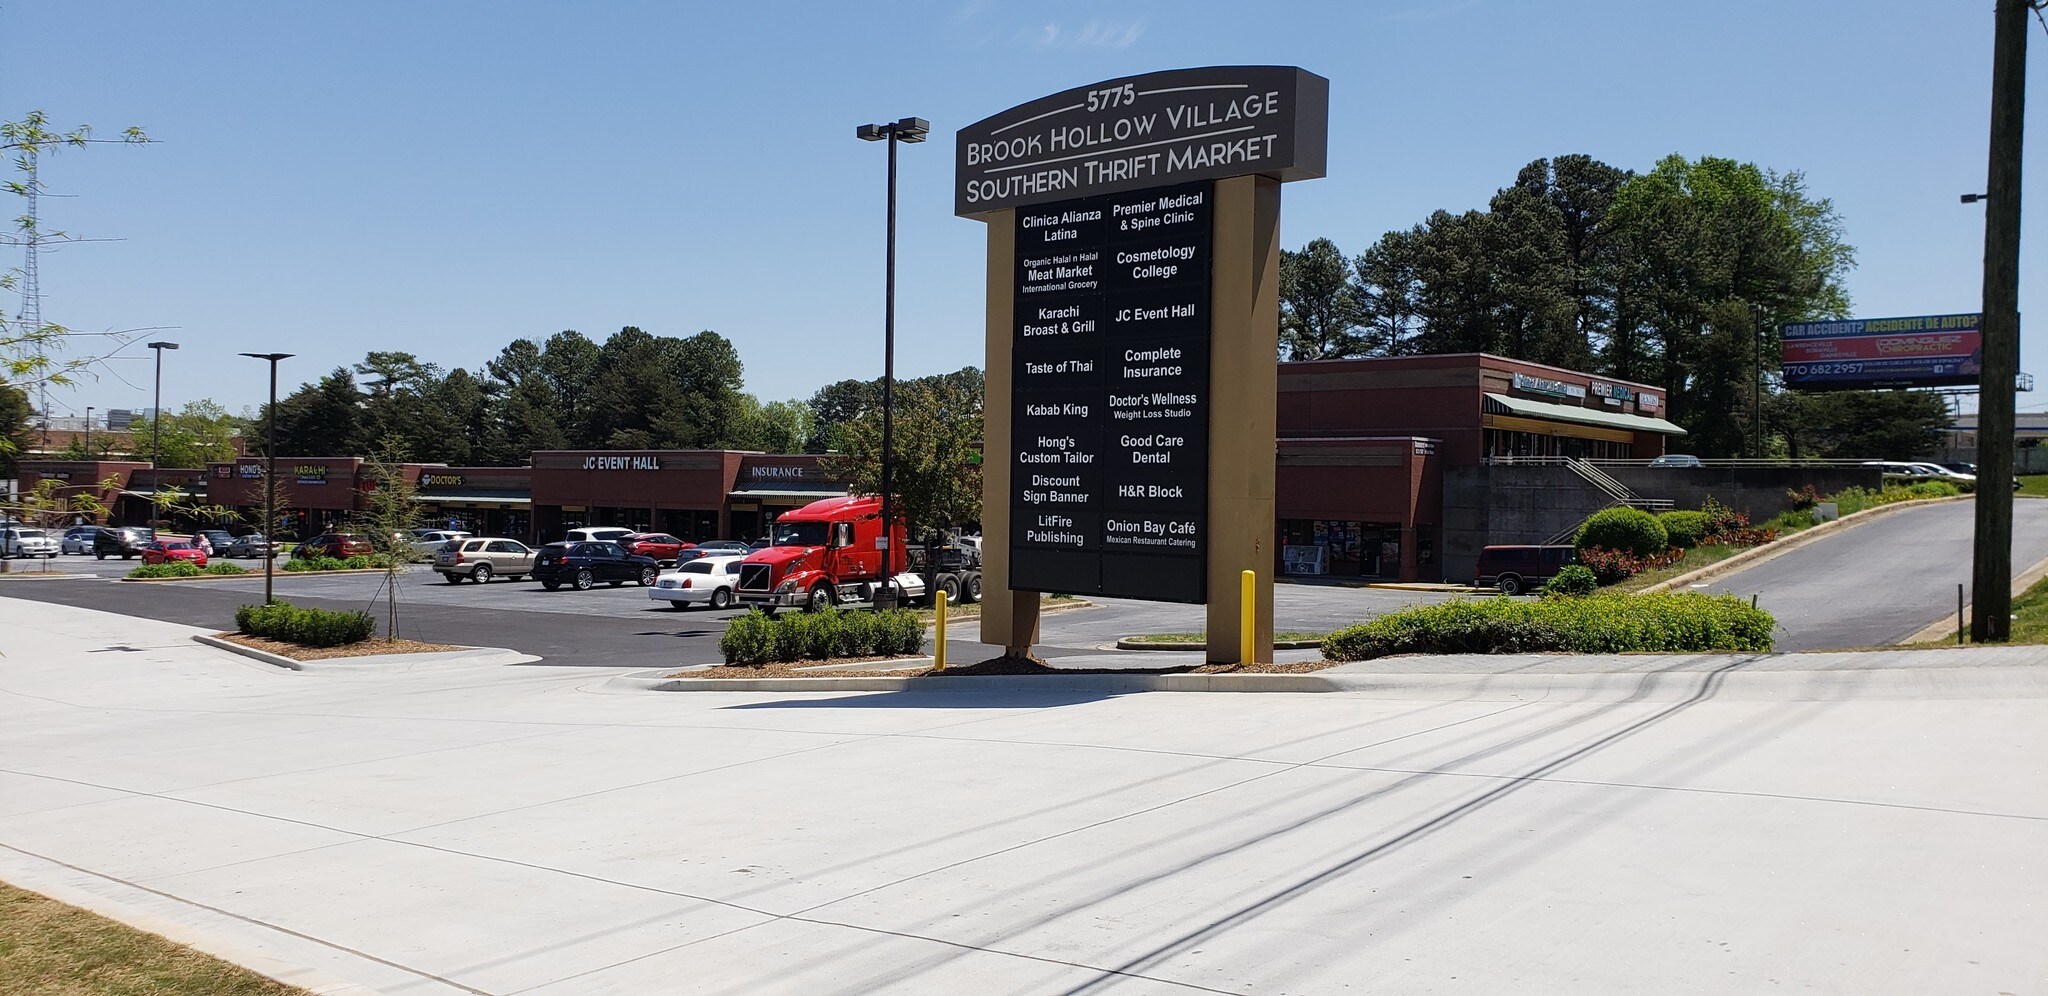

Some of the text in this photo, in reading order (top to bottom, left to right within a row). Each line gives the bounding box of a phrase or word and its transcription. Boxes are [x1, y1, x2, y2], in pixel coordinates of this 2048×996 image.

[1087, 83, 1134, 112] 5775
[968, 91, 1279, 166] BROOK HOLLOW VILLAGE
[967, 134, 1278, 202] SOUTHERN THRIFT MARKET
[1113, 192, 1202, 217] Premier Medical
[1023, 211, 1101, 228] Clinica Alianza
[1121, 211, 1193, 230] & Spine Clinic
[1045, 229, 1077, 241] Latina
[1024, 258, 1052, 269] Organic
[1053, 255, 1071, 263] Halal
[1080, 252, 1098, 261] Halal
[1117, 246, 1195, 265] Cosmetology
[1029, 265, 1092, 281] Meat Market
[1133, 265, 1177, 278] College
[1023, 281, 1097, 293] International Grocery
[1039, 306, 1079, 319] Karachi
[1116, 304, 1194, 322] JC Event Hall
[1024, 320, 1094, 336] Broast & Grill
[1785, 315, 1978, 336] CAR ACCIDENT? ACCIDENTE DE AUTO?
[1882, 343, 1952, 353] CHIROPRACTIC
[1125, 348, 1181, 362] Complete
[1026, 360, 1092, 373] Taste of Thai
[1124, 366, 1181, 378] Insurance
[1784, 366, 1807, 375] 770
[1811, 365, 1831, 374] 682
[1834, 364, 1863, 373] 2957
[1592, 382, 1612, 397] PREMIER
[1110, 393, 1196, 406] Doctor's Wellness
[1027, 404, 1088, 417] Kabab King
[1114, 409, 1191, 420] Weight Loss Studio
[1039, 436, 1075, 450] Hong's
[1121, 435, 1183, 446] Good Care
[583, 457, 659, 470] JC EVENT HALL
[1020, 452, 1094, 463] Custom Tailor
[1133, 451, 1170, 463] Dental
[240, 464, 261, 474] HONG'S
[752, 467, 803, 477] INSURANCE
[431, 475, 462, 485] DOCTOR'S
[1033, 475, 1079, 486] Discount
[1024, 490, 1088, 504] Sign Banner
[1119, 485, 1182, 497] H&R Block
[1039, 515, 1072, 527] LitFire
[1107, 520, 1195, 536] Onion Bay Café
[1028, 531, 1083, 546] Publishing
[1133, 537, 1166, 545] Restaurant
[1169, 538, 1195, 548] Catering
